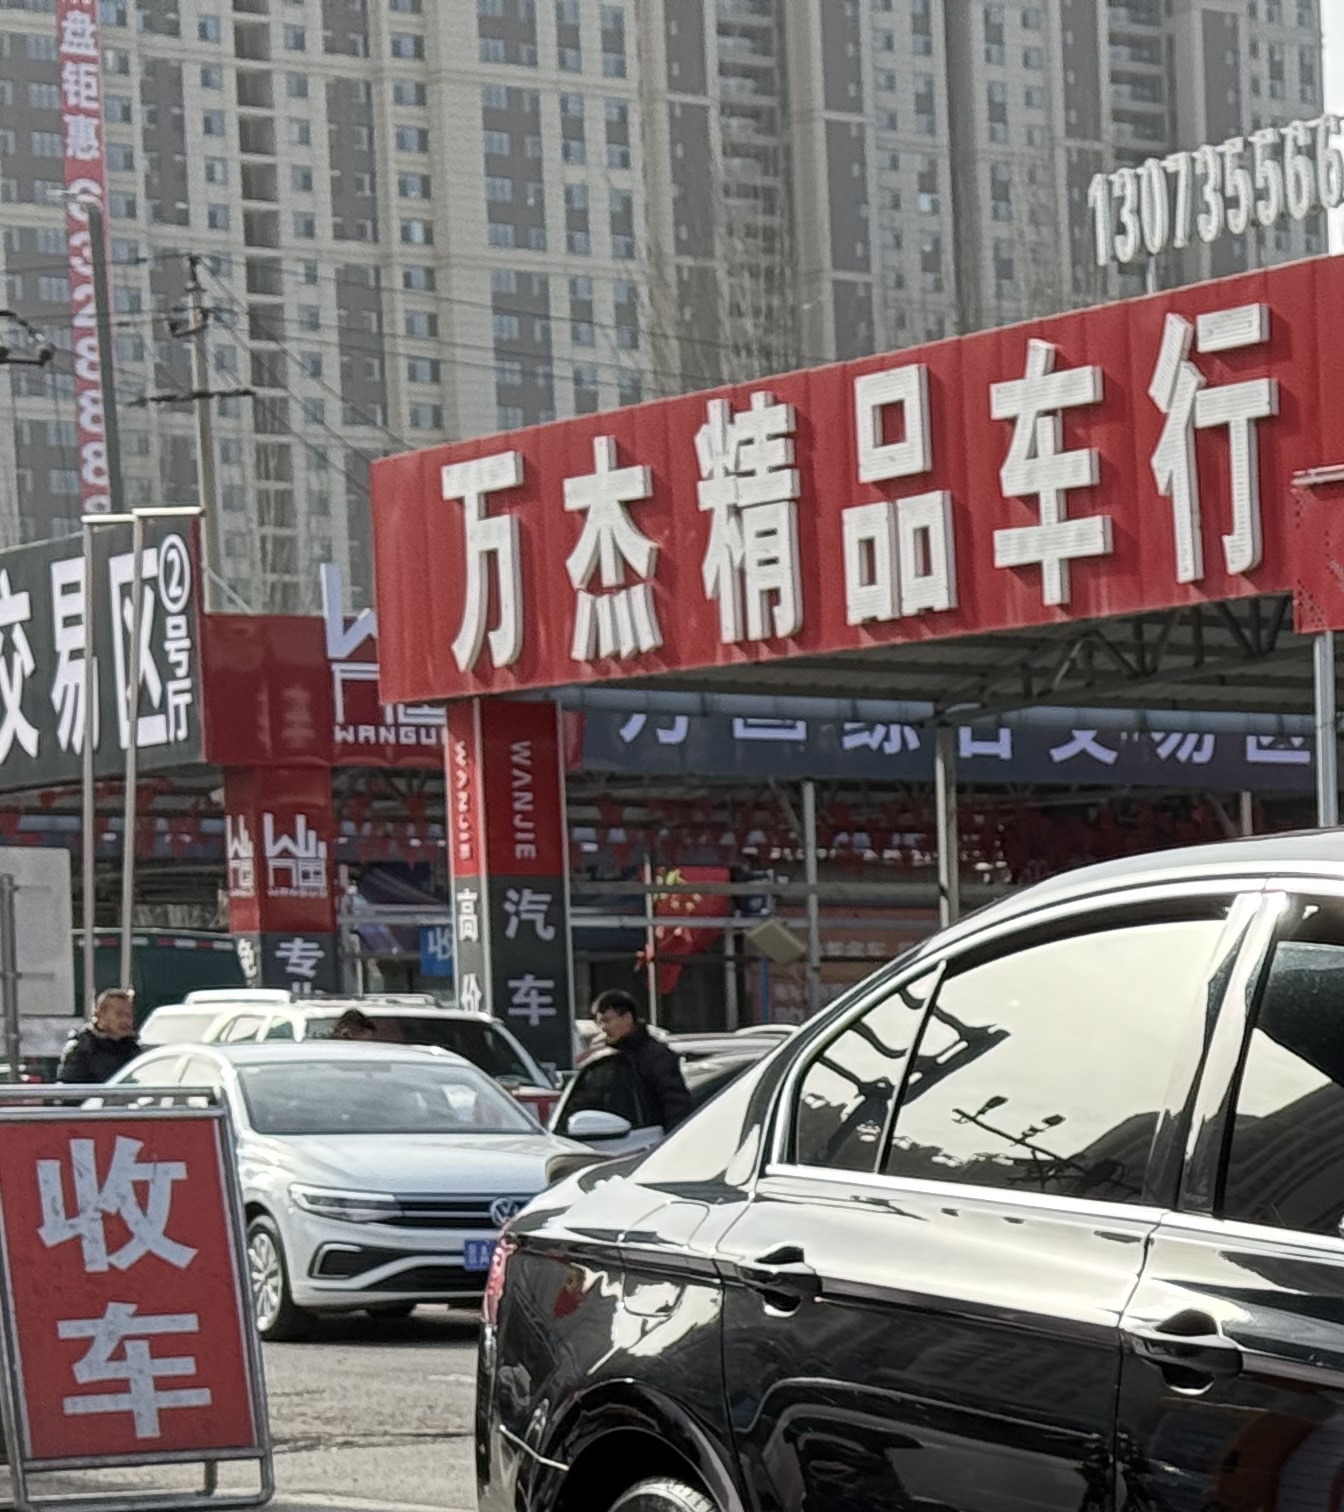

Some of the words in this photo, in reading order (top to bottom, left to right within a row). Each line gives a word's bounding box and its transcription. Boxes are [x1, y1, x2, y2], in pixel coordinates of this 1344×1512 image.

[441, 302, 1280, 673] 万杰精品车行
[509, 740, 537, 861] WANJIE
[36, 1135, 212, 1440] 收车
